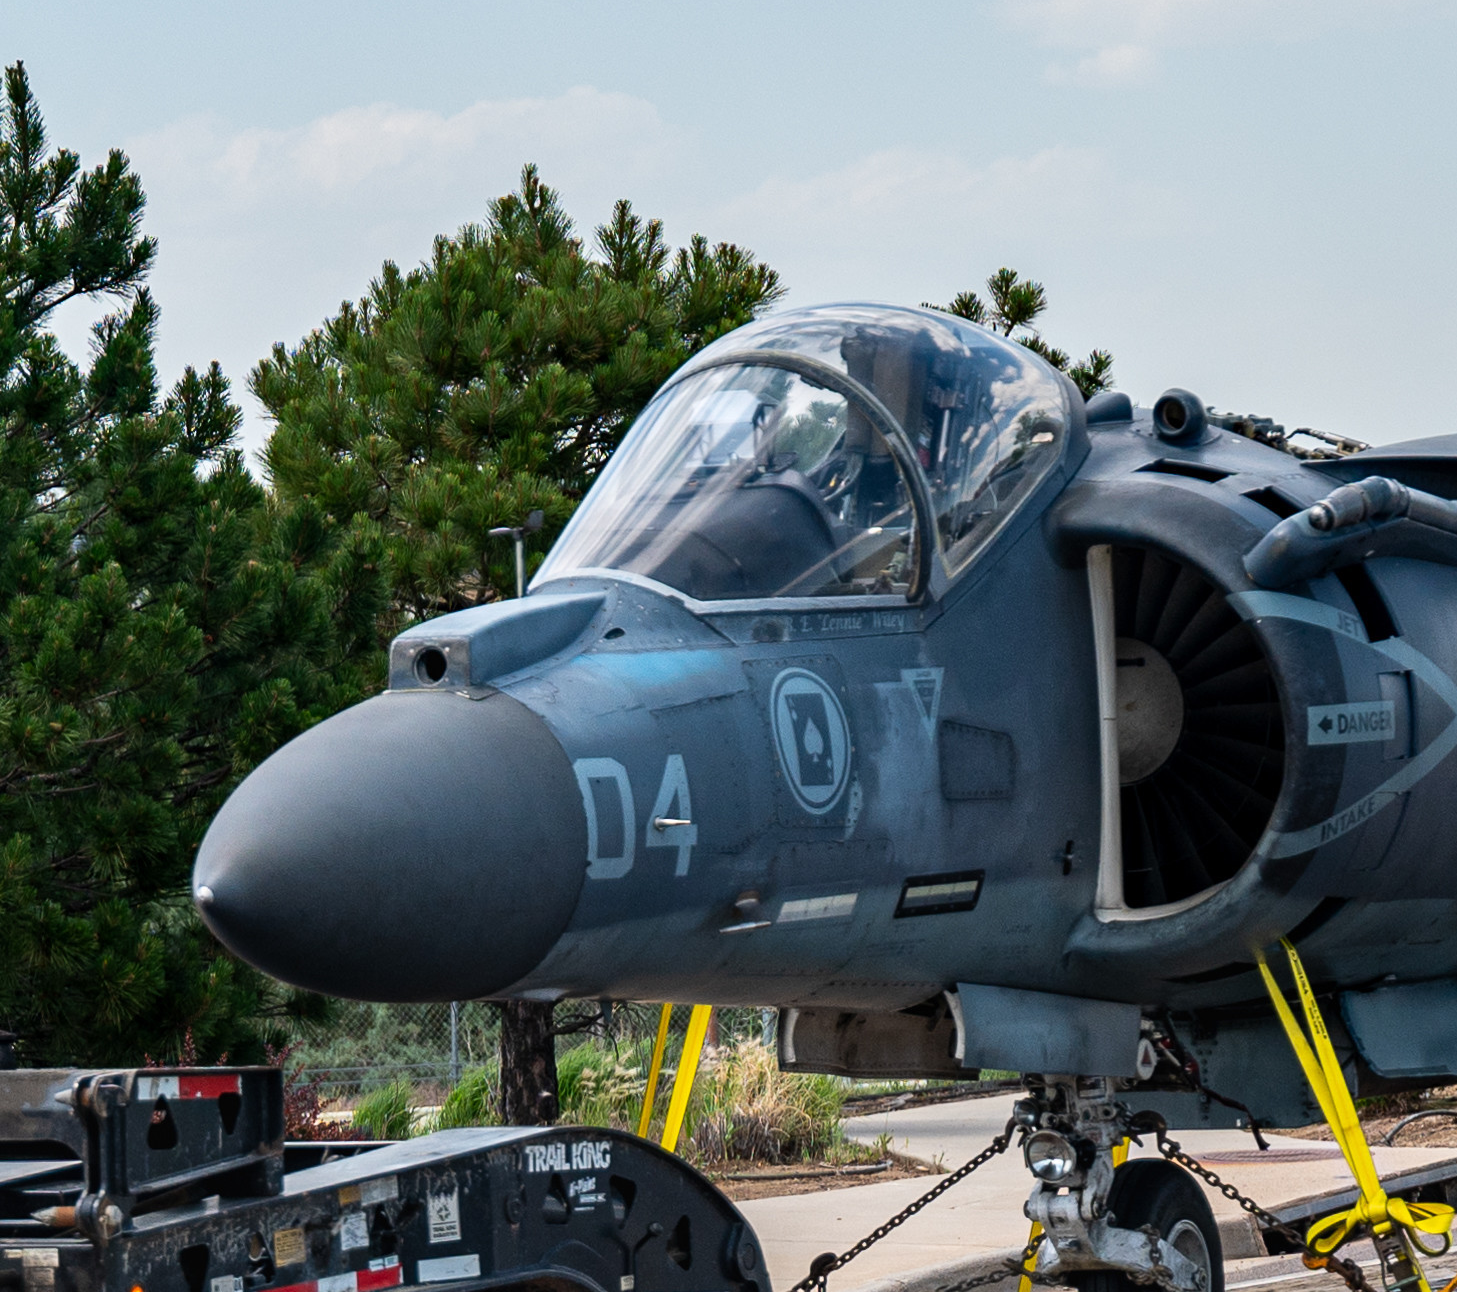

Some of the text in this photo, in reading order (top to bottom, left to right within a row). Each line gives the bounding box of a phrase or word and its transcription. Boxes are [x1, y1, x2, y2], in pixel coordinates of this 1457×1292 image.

[1338, 614, 1360, 637] JET
[1338, 710, 1393, 735] DANGER
[1320, 795, 1376, 842] INTAKE
